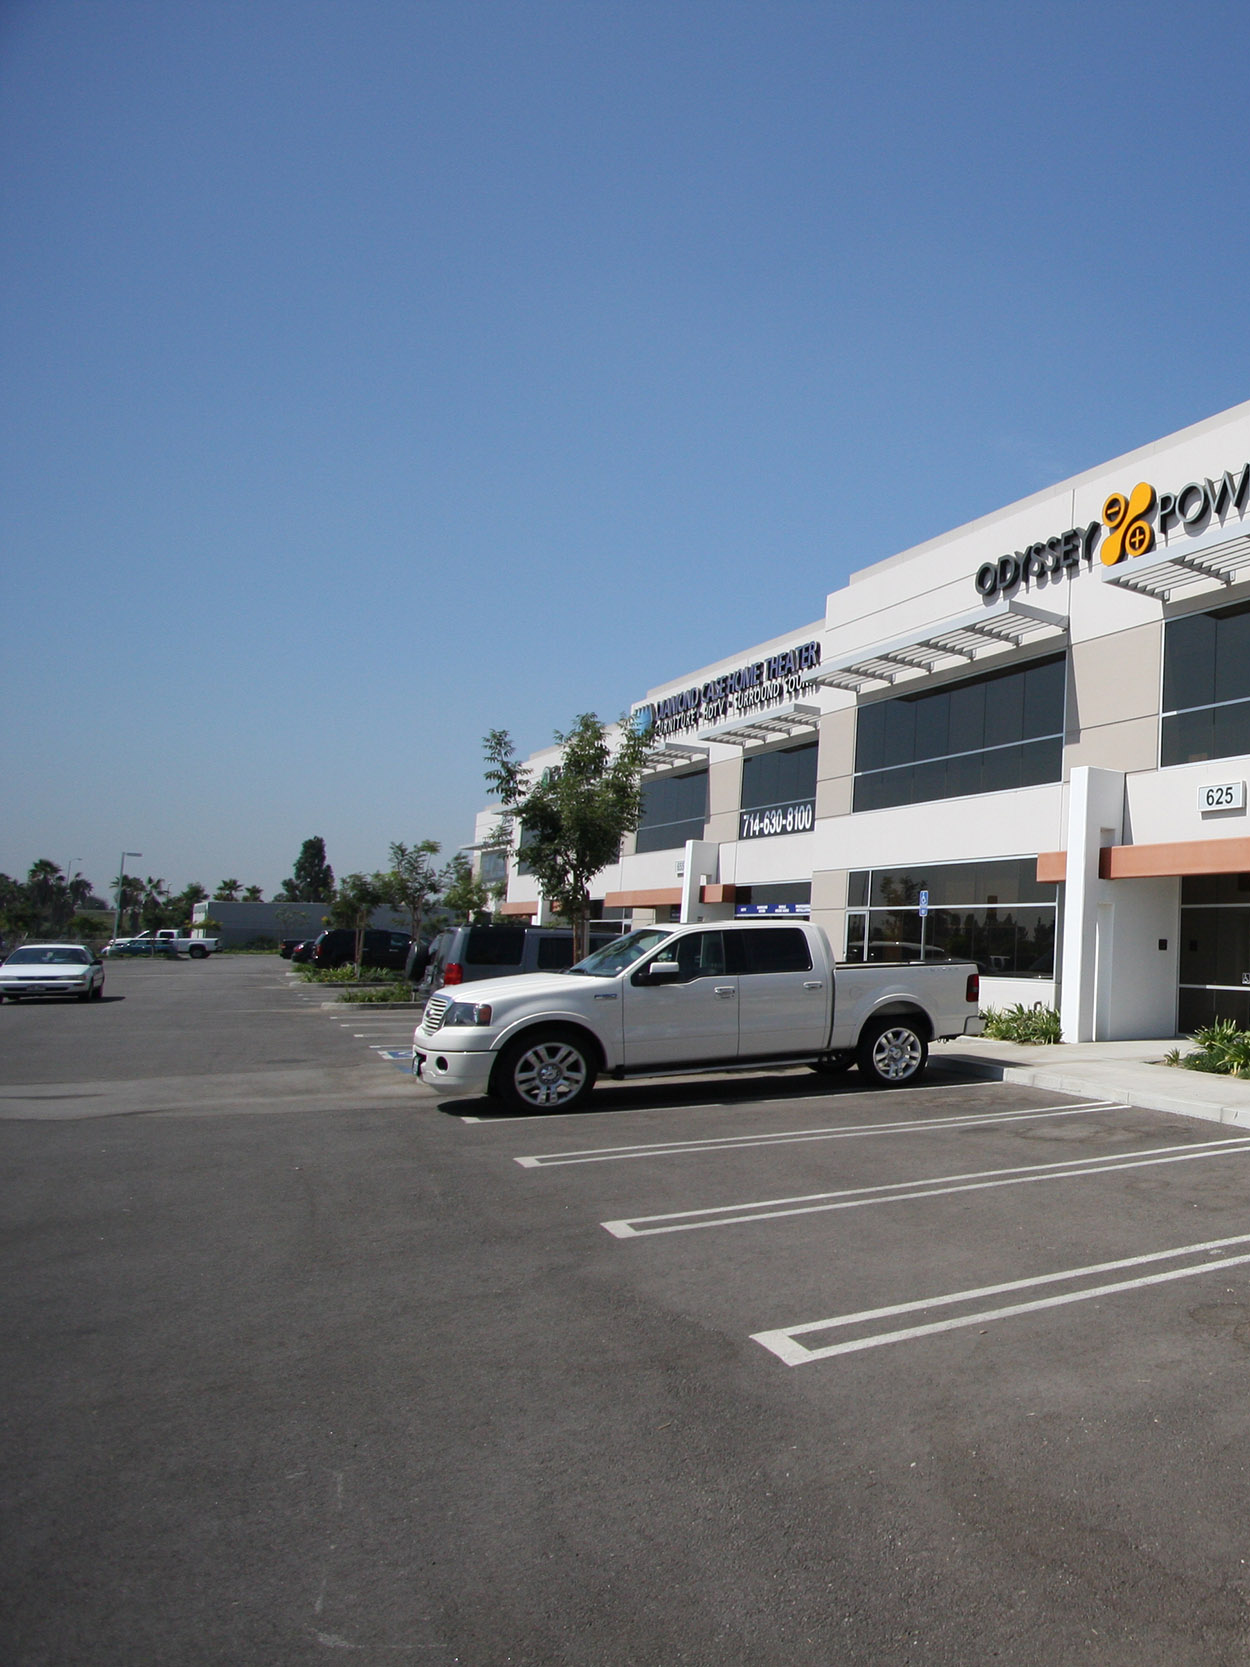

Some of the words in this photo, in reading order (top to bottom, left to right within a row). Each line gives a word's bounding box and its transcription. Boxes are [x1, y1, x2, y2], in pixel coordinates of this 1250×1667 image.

[975, 521, 1100, 595] ODYSSEY
[656, 687, 701, 721] DIAMOND
[701, 678, 728, 703] CASE
[727, 662, 763, 694] HOME
[764, 641, 820, 680] THEATER
[703, 698, 726, 721] HDTV
[733, 679, 780, 710] SURROUND
[783, 673, 813, 694] SOU
[1206, 786, 1234, 806] 625
[743, 804, 812, 837] 714-630-8100
